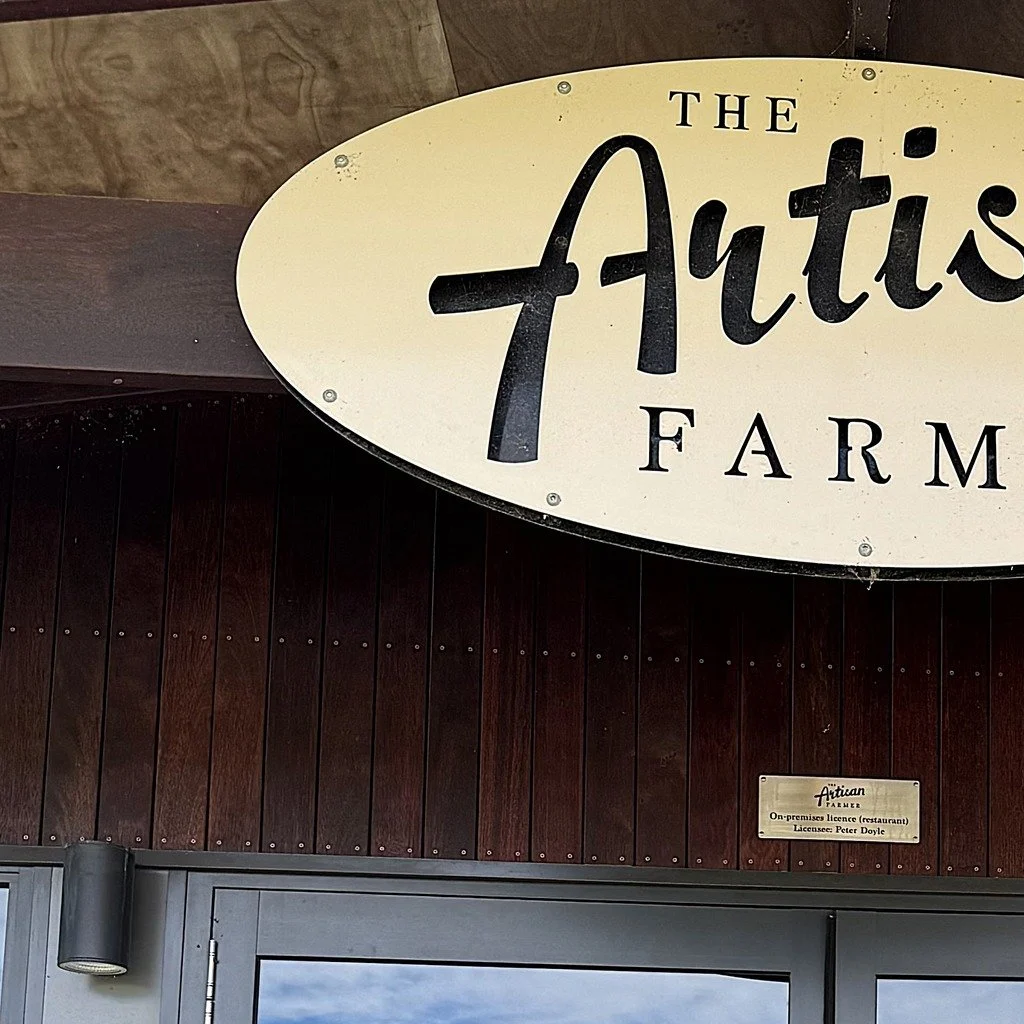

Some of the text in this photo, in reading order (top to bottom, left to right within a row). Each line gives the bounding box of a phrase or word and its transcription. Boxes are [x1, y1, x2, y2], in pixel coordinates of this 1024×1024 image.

[669, 90, 799, 134] THE
[813, 784, 866, 807] Artisan
[769, 811, 909, 826] On-premises licence (restaurant)
[793, 824, 886, 836] Licensee: Peter Doyle
